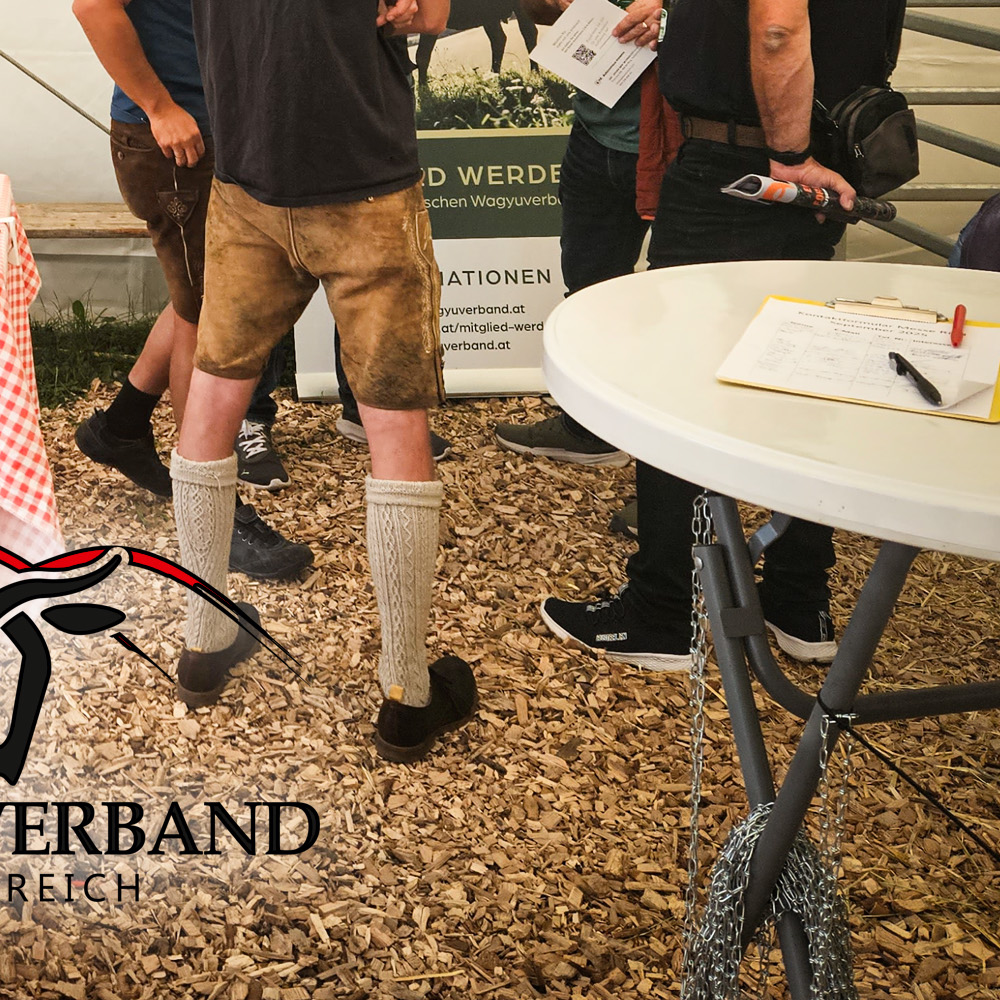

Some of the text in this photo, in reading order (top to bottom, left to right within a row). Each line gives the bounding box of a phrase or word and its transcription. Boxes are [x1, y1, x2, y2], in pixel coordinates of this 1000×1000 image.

[421, 167, 446, 187] D
[424, 195, 468, 209] schen
[439, 268, 551, 287] ATIONEN
[441, 339, 511, 351] verband.at
